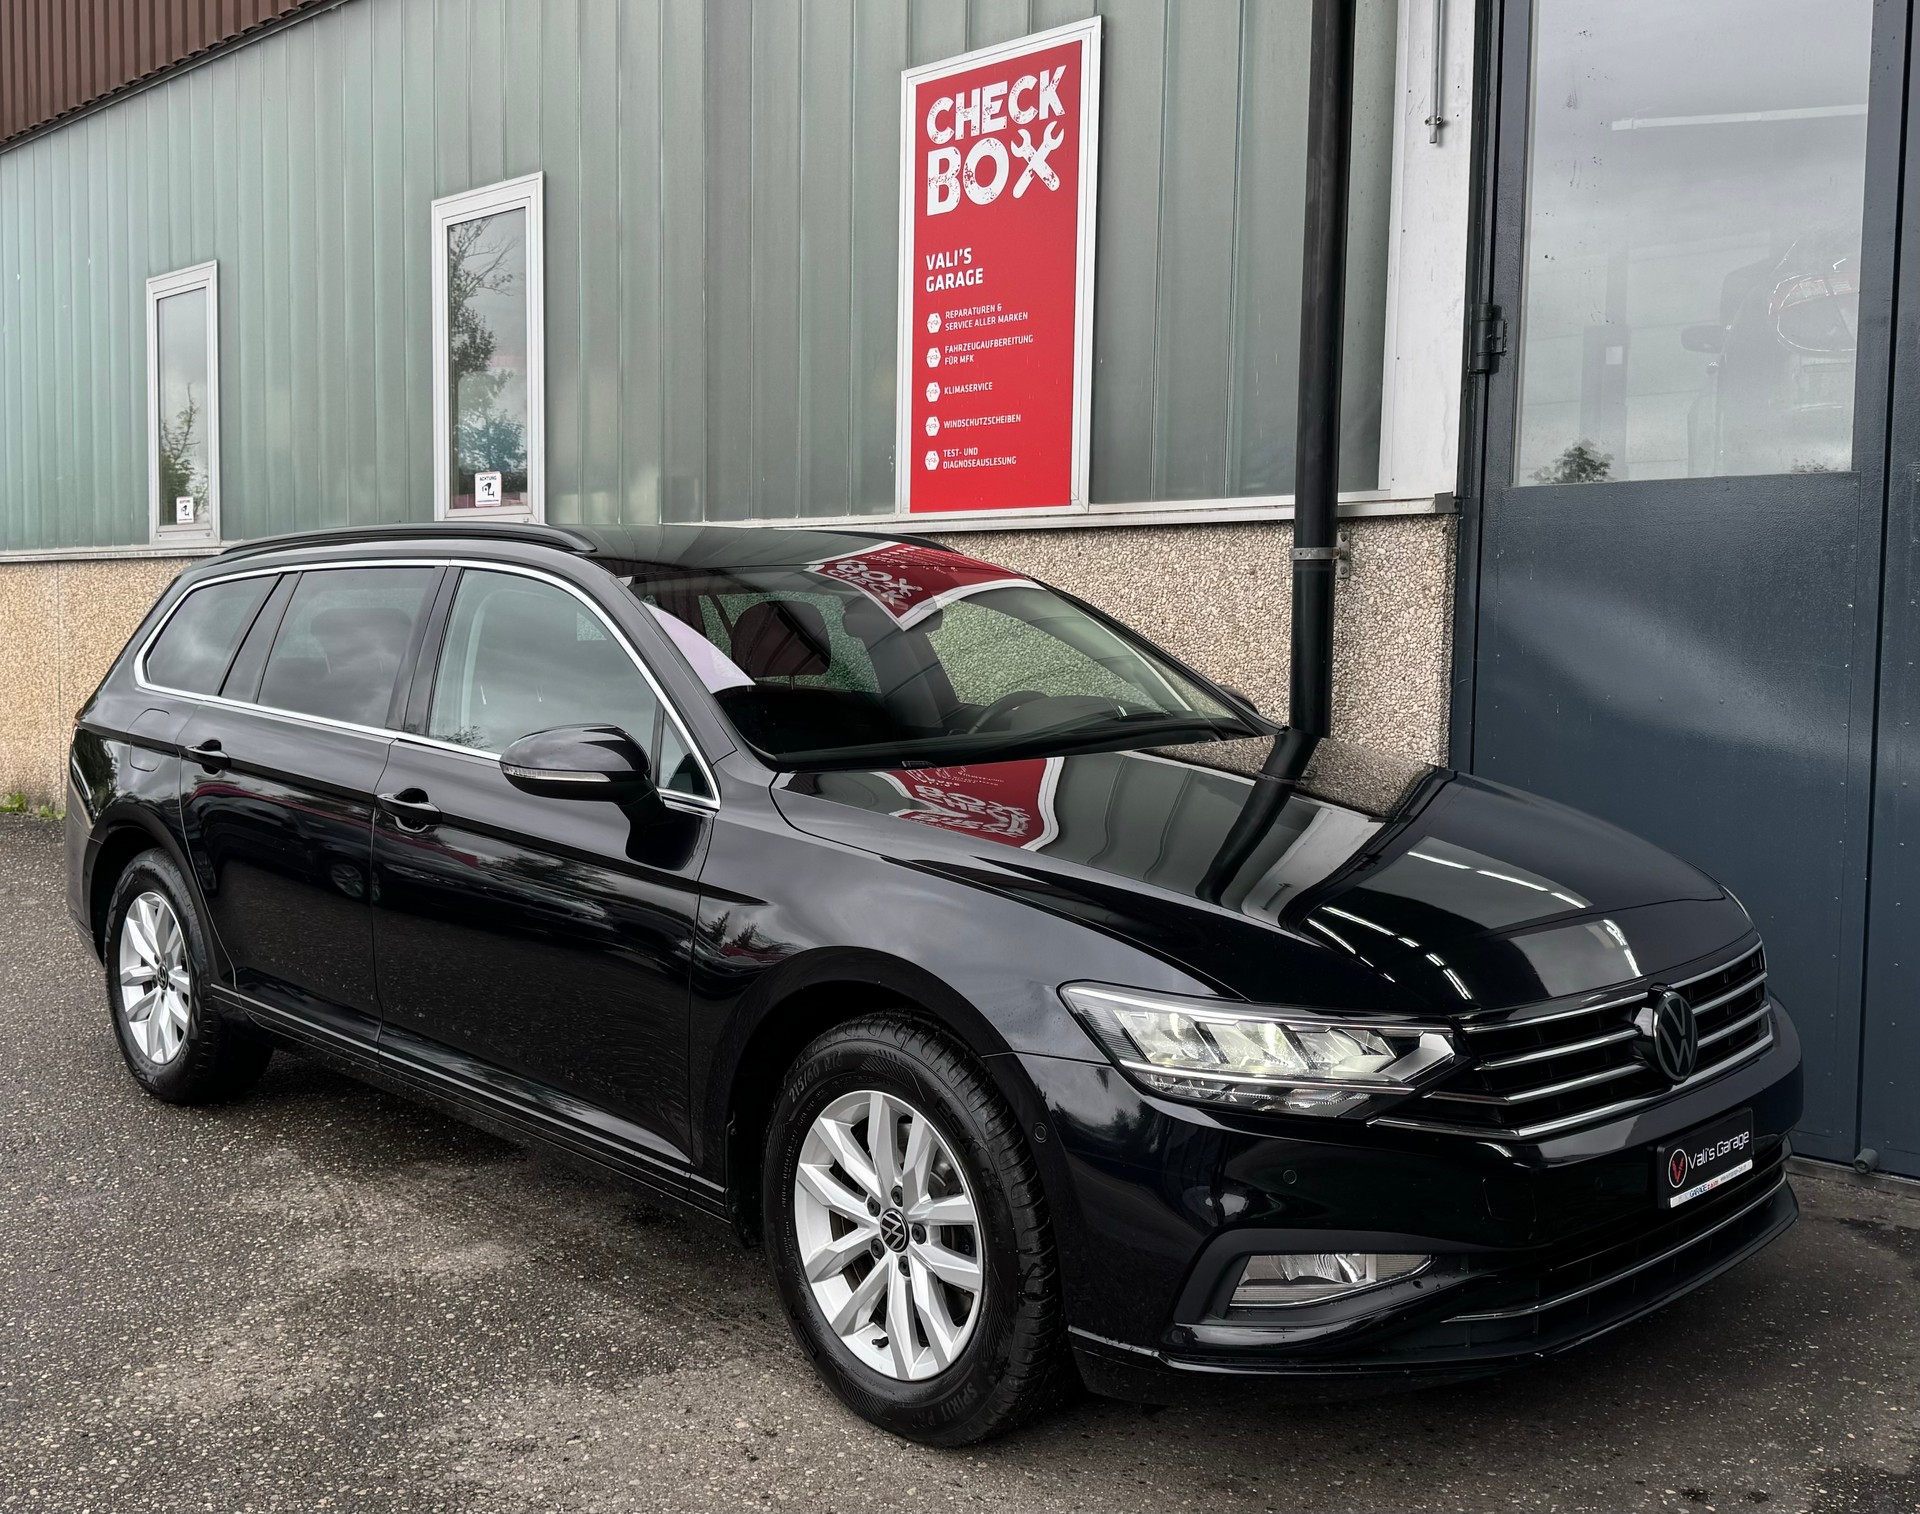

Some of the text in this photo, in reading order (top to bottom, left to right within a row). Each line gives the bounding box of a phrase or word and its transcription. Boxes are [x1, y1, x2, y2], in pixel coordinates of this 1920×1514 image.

[926, 65, 1067, 145] CHECK
[926, 121, 1065, 216] BOX
[926, 247, 972, 271] VALI'S
[926, 268, 984, 292] GARAGE
[945, 303, 1003, 319] REPARATUREN &
[945, 312, 1028, 331] SERVICE ALLER MARKEN
[944, 335, 1034, 354] FAHRZEUGAUFBEREITUNG
[944, 354, 974, 366] FÜR MFK
[944, 382, 993, 395] KLIMASERVICE
[943, 414, 1021, 429] WINDSCHUTZSCHEIBEN
[943, 447, 978, 458] TEST- UND
[943, 456, 1017, 469] DIAGNOSEAUSLESUNG
[1716, 1131, 1750, 1157] Garage
